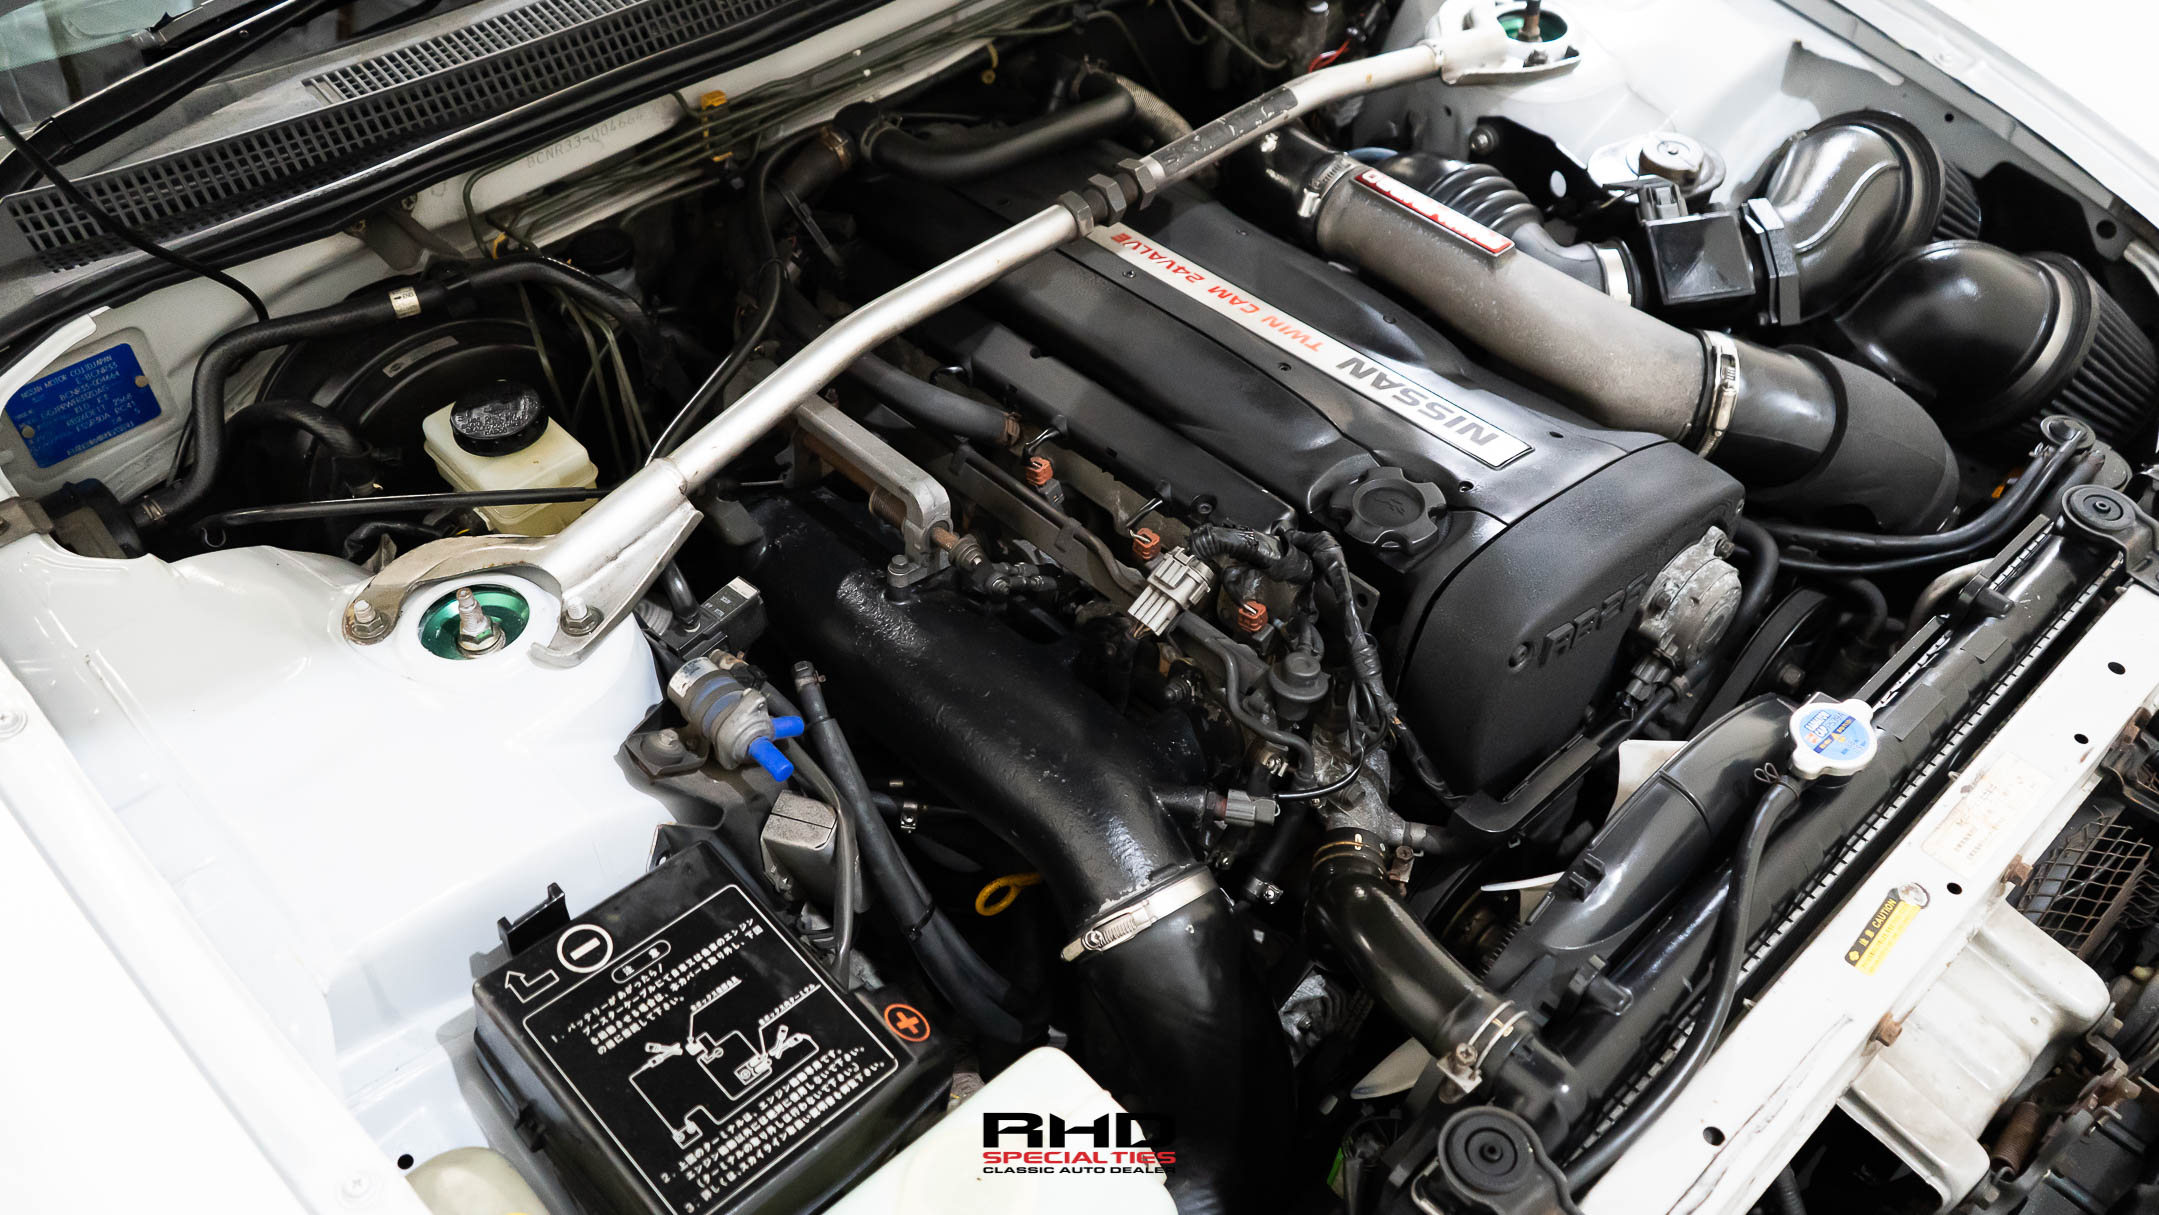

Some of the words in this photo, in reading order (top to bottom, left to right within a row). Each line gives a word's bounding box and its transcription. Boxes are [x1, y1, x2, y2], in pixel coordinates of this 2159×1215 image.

[1110, 232, 1205, 285] 24VALVE
[1208, 285, 1260, 314] CAM
[1262, 314, 1323, 352] TWIN
[44, 374, 67, 391] MOTOR
[1336, 356, 1500, 446] NISSAN
[1872, 898, 1897, 928] CAUTION
